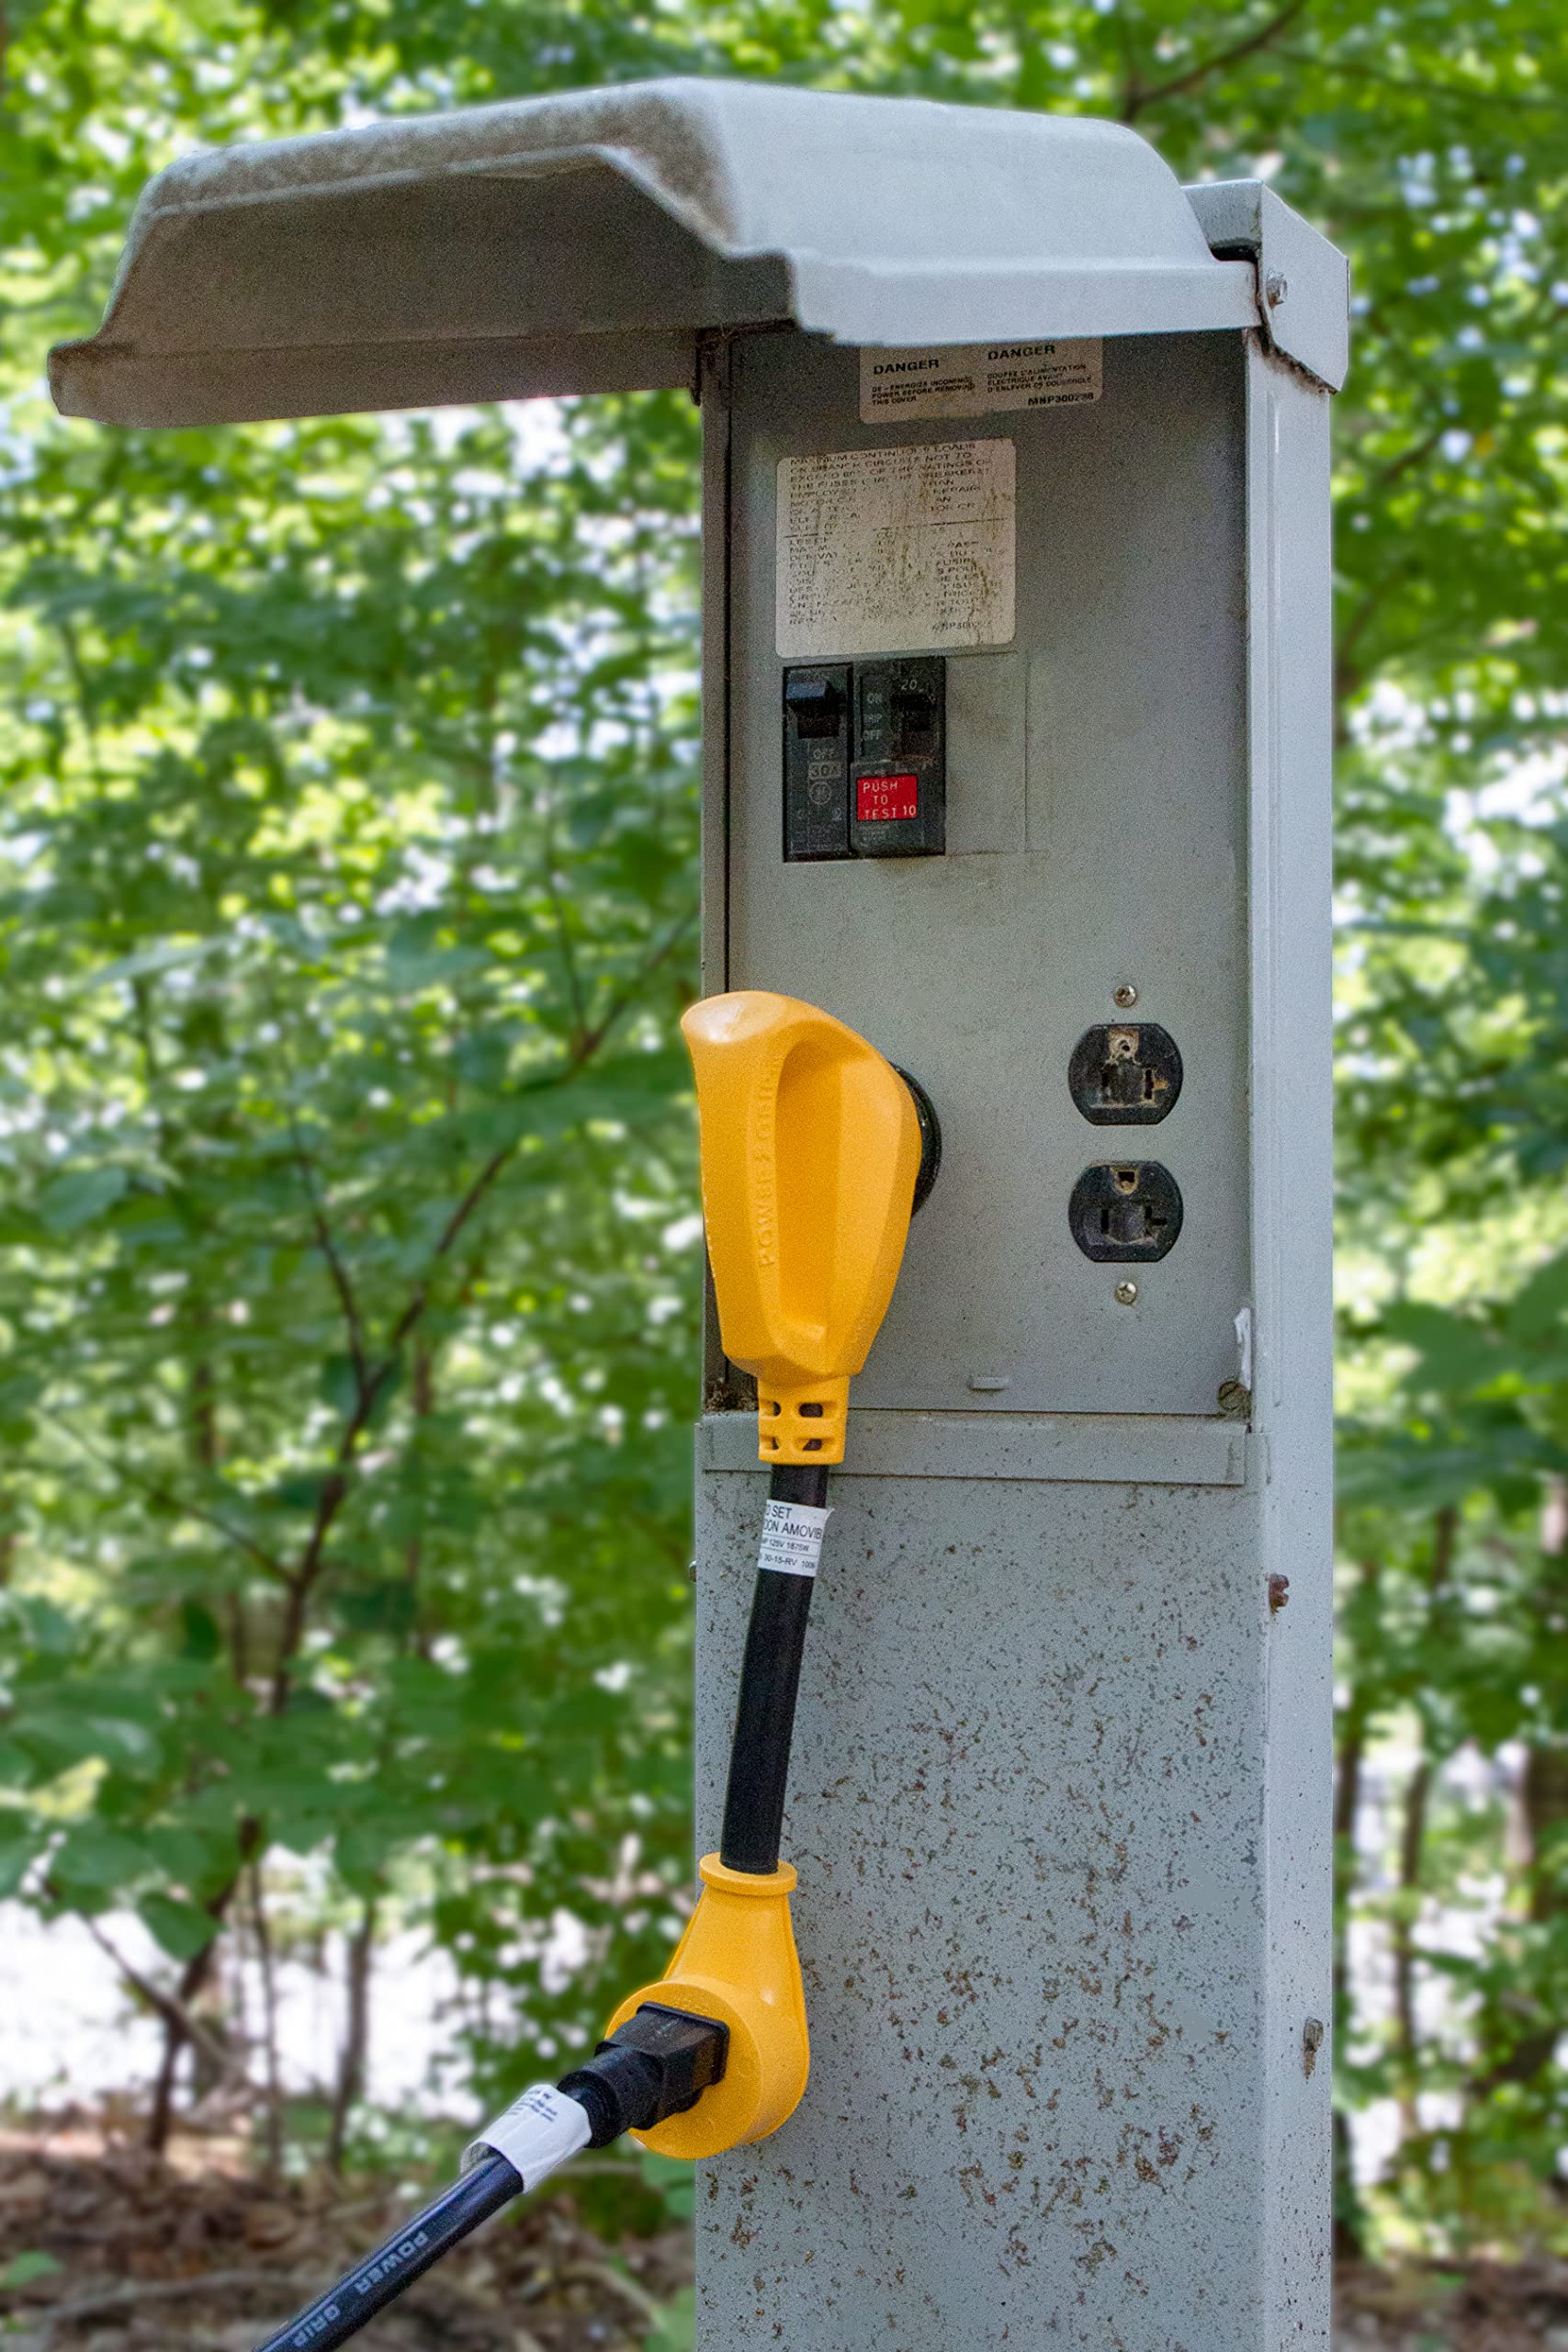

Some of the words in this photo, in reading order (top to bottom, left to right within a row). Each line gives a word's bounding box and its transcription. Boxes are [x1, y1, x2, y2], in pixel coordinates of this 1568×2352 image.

[987, 345, 1055, 360] DANGER
[874, 359, 940, 375] DANGER
[901, 679, 918, 691] 20
[867, 693, 883, 705] ON
[863, 781, 898, 794] PUSH
[873, 795, 889, 806] TO
[902, 805, 918, 817] 10
[772, 1504, 793, 1521] SET
[355, 2231, 429, 2295] POWER
[293, 2303, 341, 2347] GRIP
